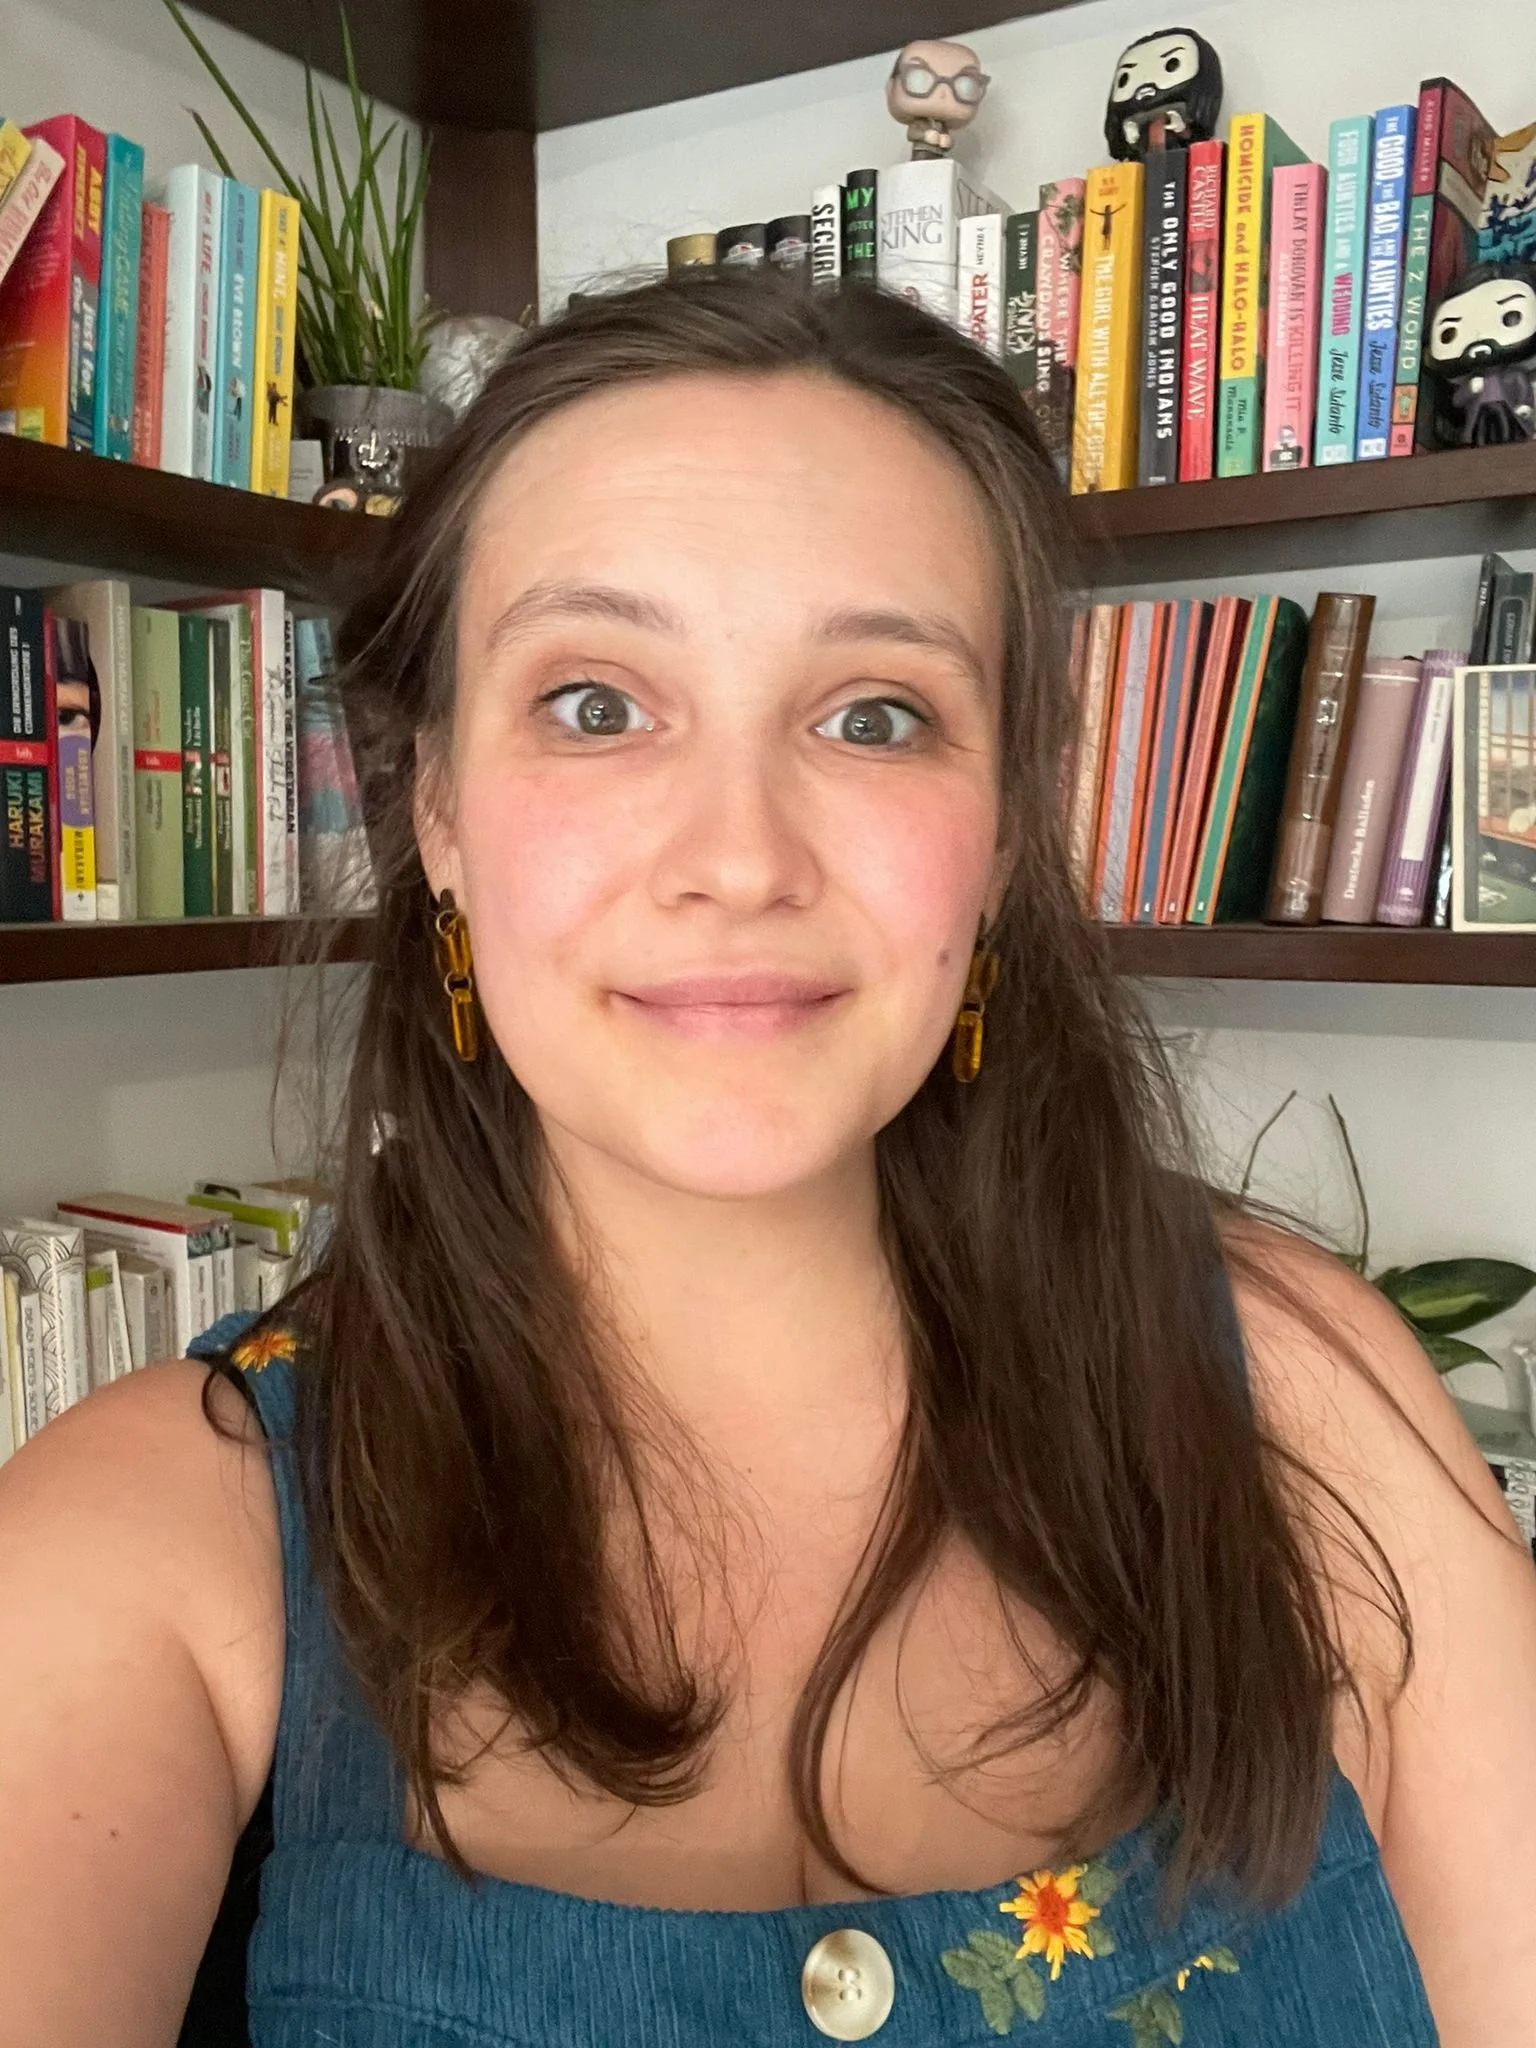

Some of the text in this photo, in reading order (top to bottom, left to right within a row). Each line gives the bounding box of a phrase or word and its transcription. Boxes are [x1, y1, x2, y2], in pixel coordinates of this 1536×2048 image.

[1336, 132, 1359, 168] FOUR
[1385, 116, 1399, 133] THE
[1373, 136, 1404, 185] GOOD,
[846, 187, 874, 210] MY
[881, 204, 944, 226] STEPHEN
[1191, 165, 1207, 231] CASTLE
[1292, 182, 1309, 232] FINLAY
[1334, 172, 1359, 234] AUNTIES
[1368, 201, 1396, 238] BAD,
[847, 242, 874, 260] THE
[881, 222, 944, 252] KING
[1230, 124, 1256, 372] HOMICIDE and HALO-HALO
[232, 273, 244, 305] EVE
[1038, 235, 1054, 341] CRAWDADS
[1094, 255, 1116, 281] THE
[1289, 239, 1308, 302] DONOVAN
[1366, 260, 1395, 331] AUNTIES
[1398, 209, 1430, 371] THE Z WORD
[1007, 290, 1036, 354] KING
[1055, 252, 1071, 362] WHERE THE
[1092, 287, 1114, 324] GIRL
[1146, 237, 1160, 388] STEPHEN GRAHAM JONES
[1156, 181, 1179, 439] THE ONLY GOOD INDIANS
[1288, 308, 1305, 322] IS
[1331, 273, 1352, 337] WEDDING
[231, 308, 244, 369] BROWN
[1091, 327, 1110, 367] WITH
[1186, 295, 1209, 420] HEAT WAVE
[1283, 325, 1304, 393] KILLING
[1036, 346, 1051, 393] SING
[1088, 372, 1109, 399] ALL
[1328, 348, 1350, 434] Jesse Sutanto
[1368, 341, 1388, 429] Jesse Sutanto
[1088, 401, 1107, 430] THE
[285, 656, 293, 698] KANG
[6, 771, 25, 848] HARUKI
[285, 740, 296, 834] VEGETARIAN
[27, 772, 46, 884] MURAKAMI
[1343, 779, 1376, 900] Deutsche Balladen
[74, 830, 85, 889] MURAKAMI
